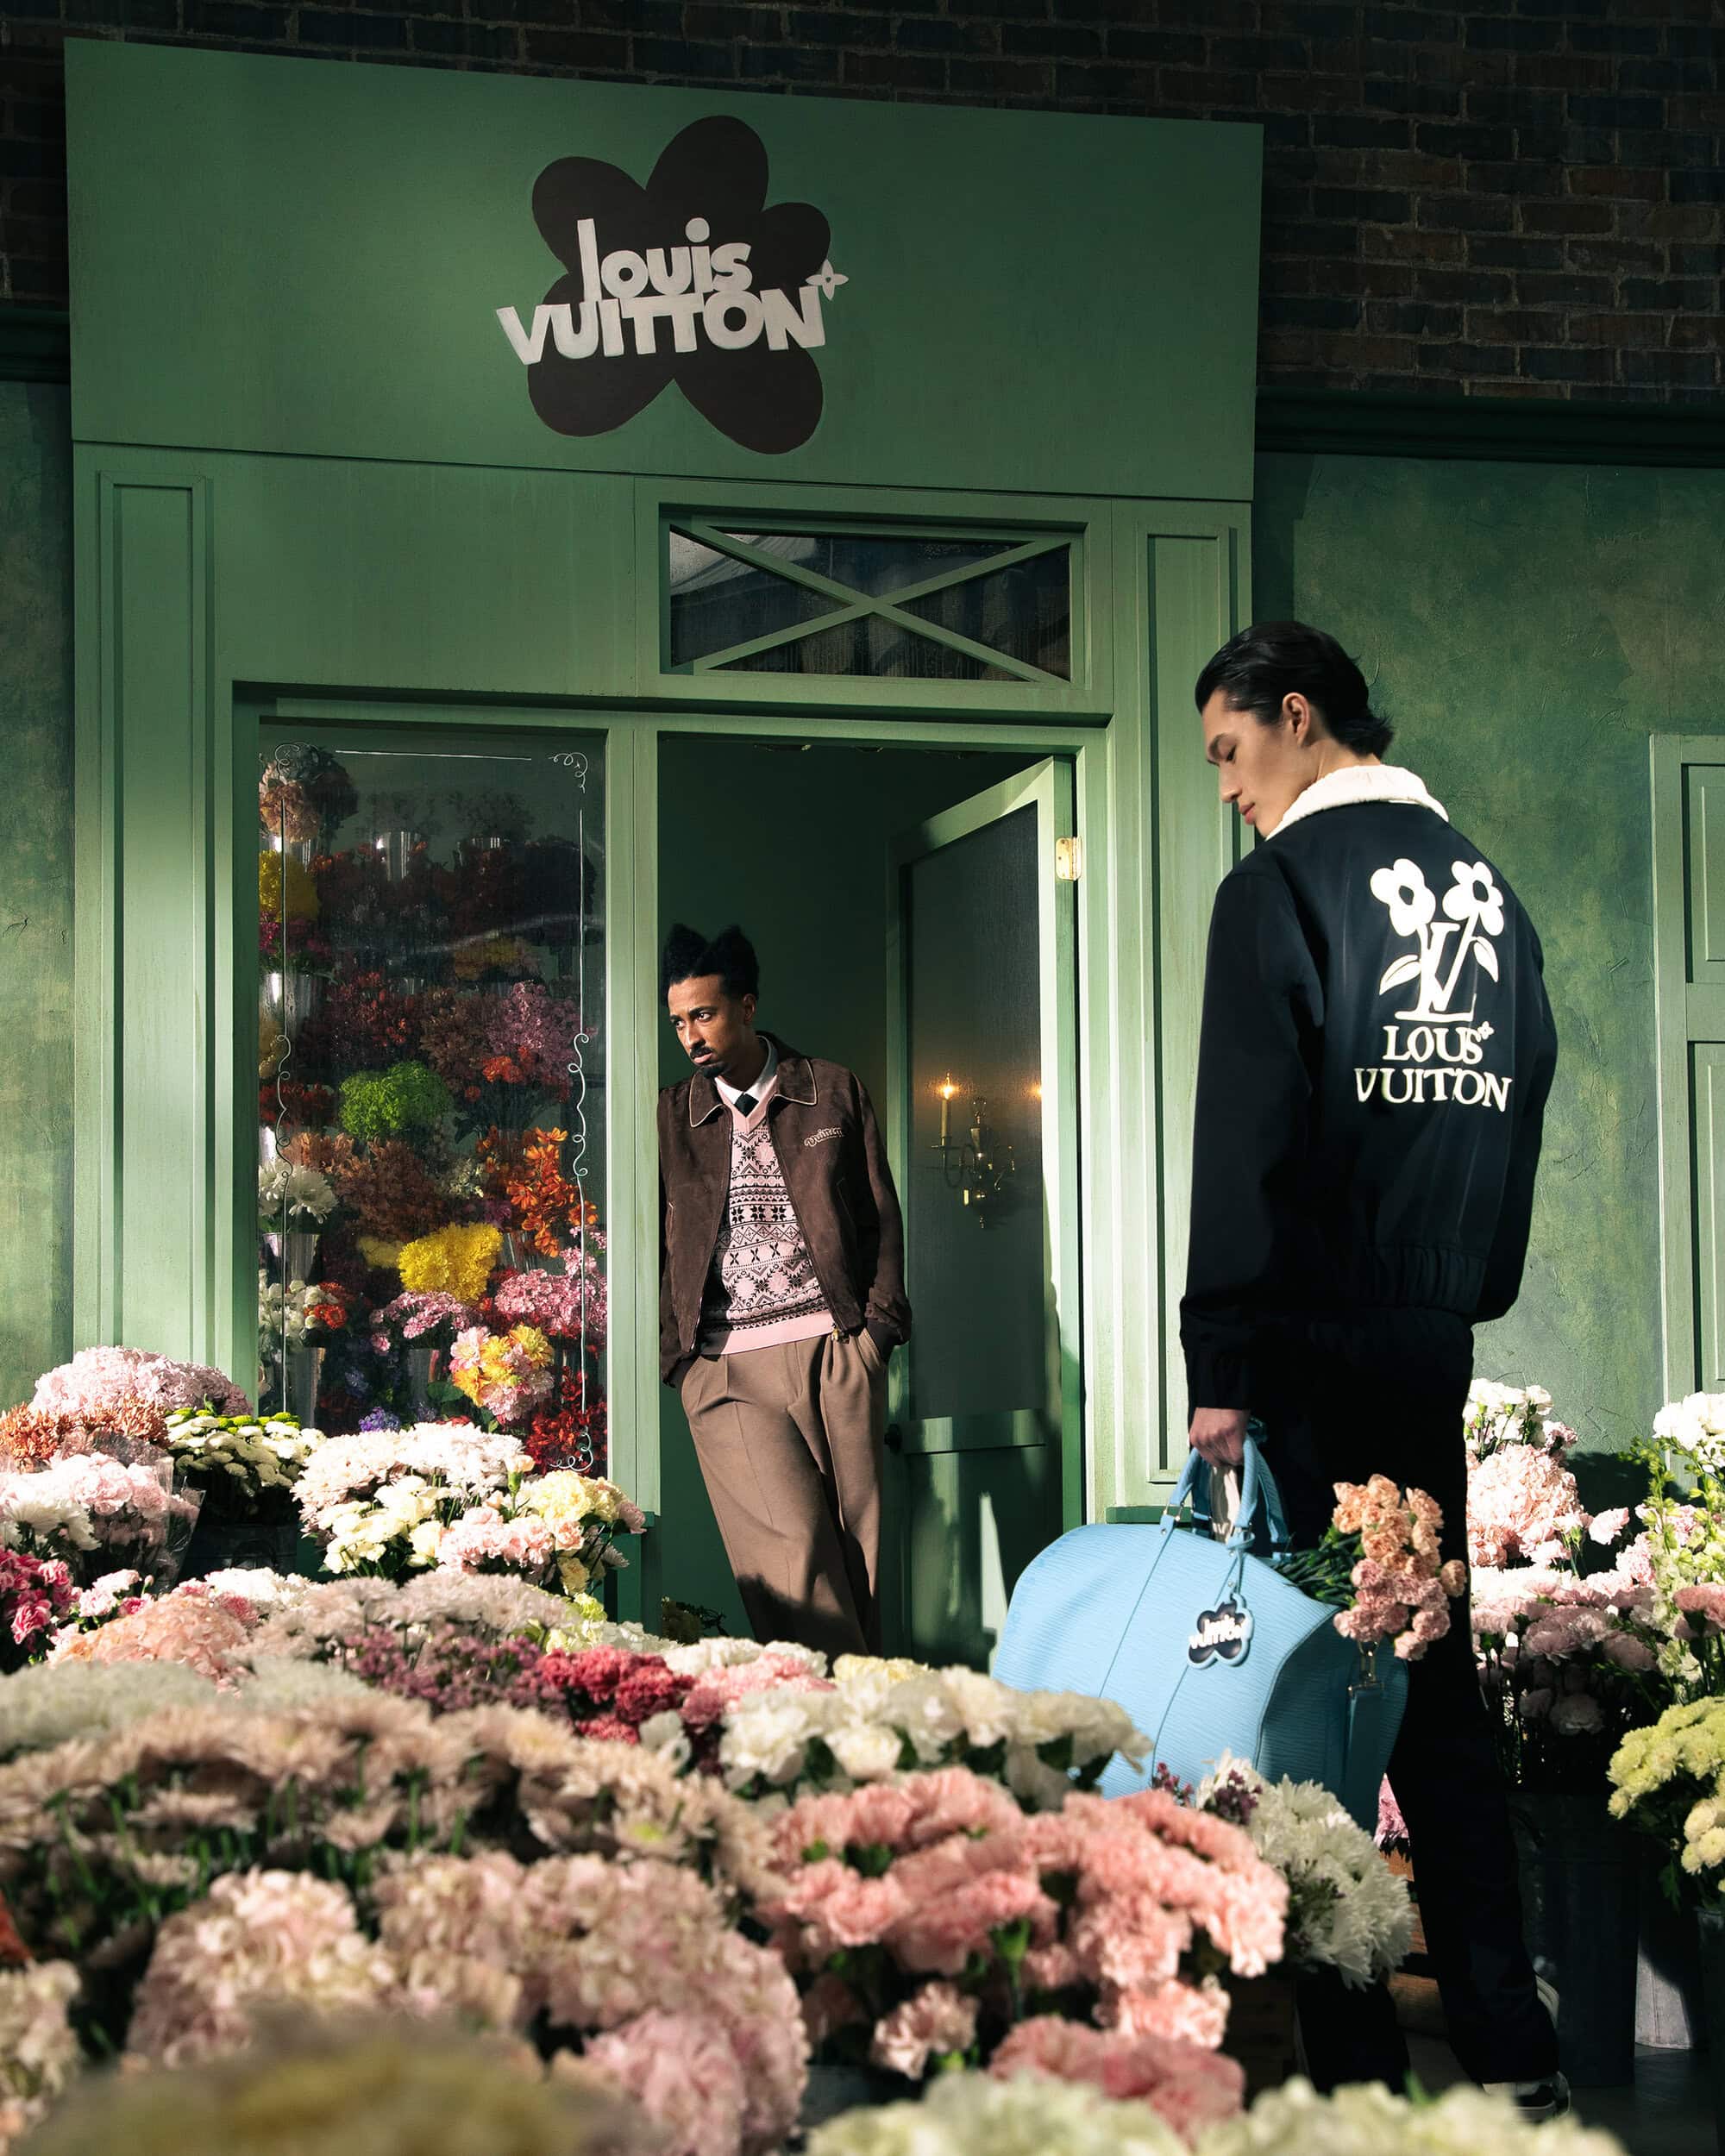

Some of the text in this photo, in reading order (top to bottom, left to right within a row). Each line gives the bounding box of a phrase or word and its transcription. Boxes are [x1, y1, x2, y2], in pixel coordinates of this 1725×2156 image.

[577, 217, 753, 303] louis
[496, 285, 826, 366] VUITTON
[1382, 1025, 1484, 1065] LOUS
[1353, 1067, 1514, 1112] VUITON
